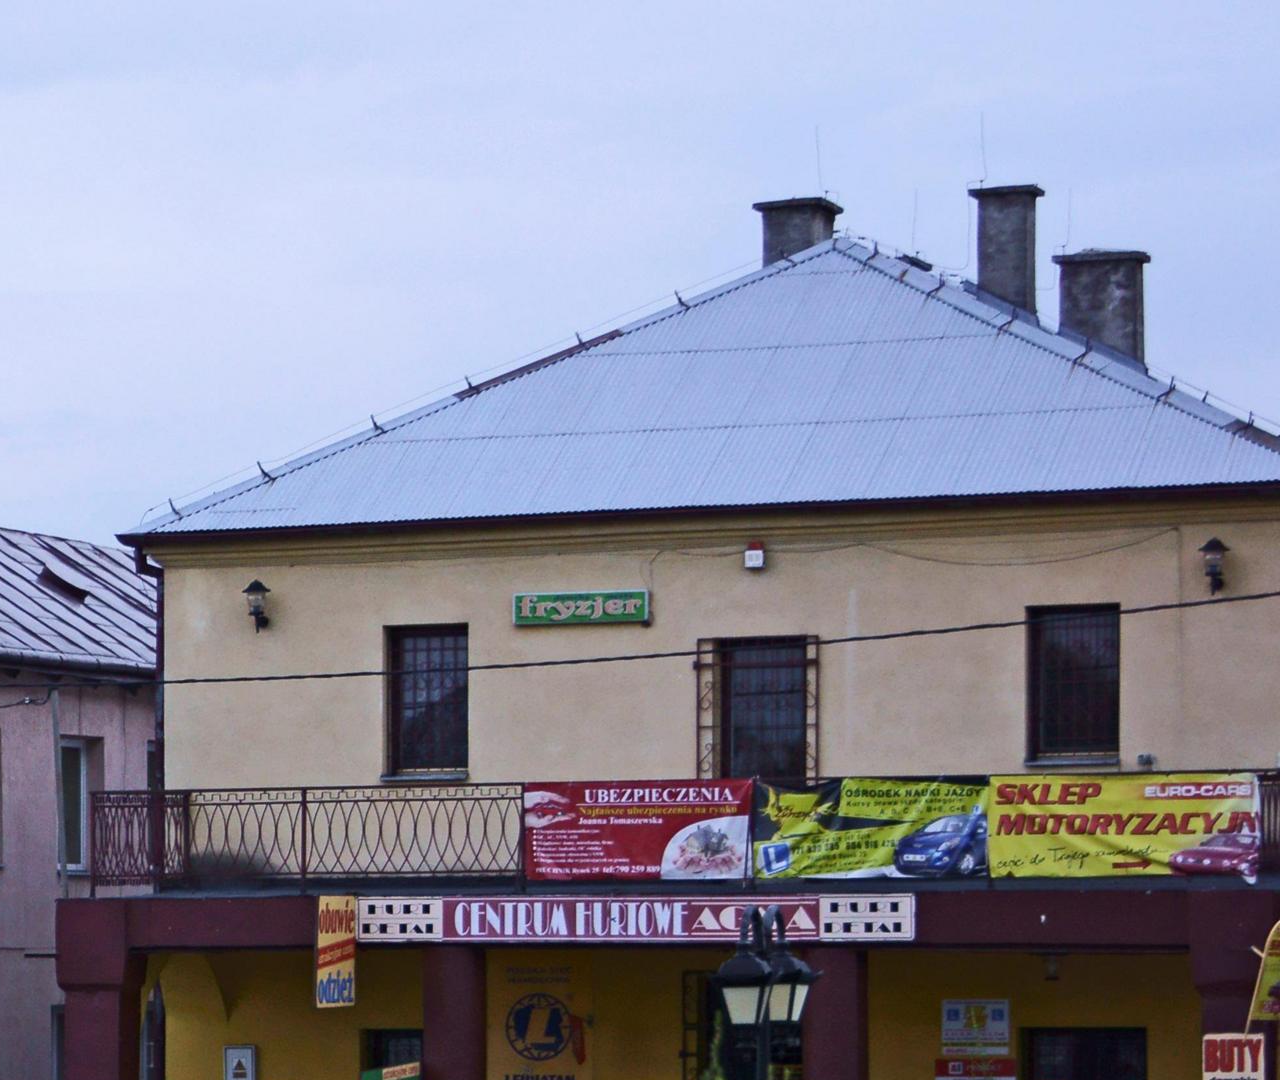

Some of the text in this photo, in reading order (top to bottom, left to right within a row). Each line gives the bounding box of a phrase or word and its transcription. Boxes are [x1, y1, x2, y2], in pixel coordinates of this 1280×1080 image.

[519, 596, 641, 620] fryzjer
[584, 787, 733, 803] UBEZPIECZENIA
[905, 787, 940, 797] NAUKI
[995, 783, 1102, 805] SKLEP
[1144, 784, 1252, 797] EURO-CARS
[626, 806, 693, 817] ubezpieczenia
[695, 807, 707, 815] na
[578, 816, 663, 825] Joanna Tomaszewska
[368, 902, 436, 914] HURT
[830, 902, 903, 913] HURT
[319, 899, 354, 934] obuwie
[454, 902, 689, 936] CENTRUM HURTOWE
[362, 922, 440, 934] DETAL
[824, 921, 909, 933] DETAL
[318, 969, 354, 1004] odzież
[1204, 1039, 1262, 1072] BUTY
